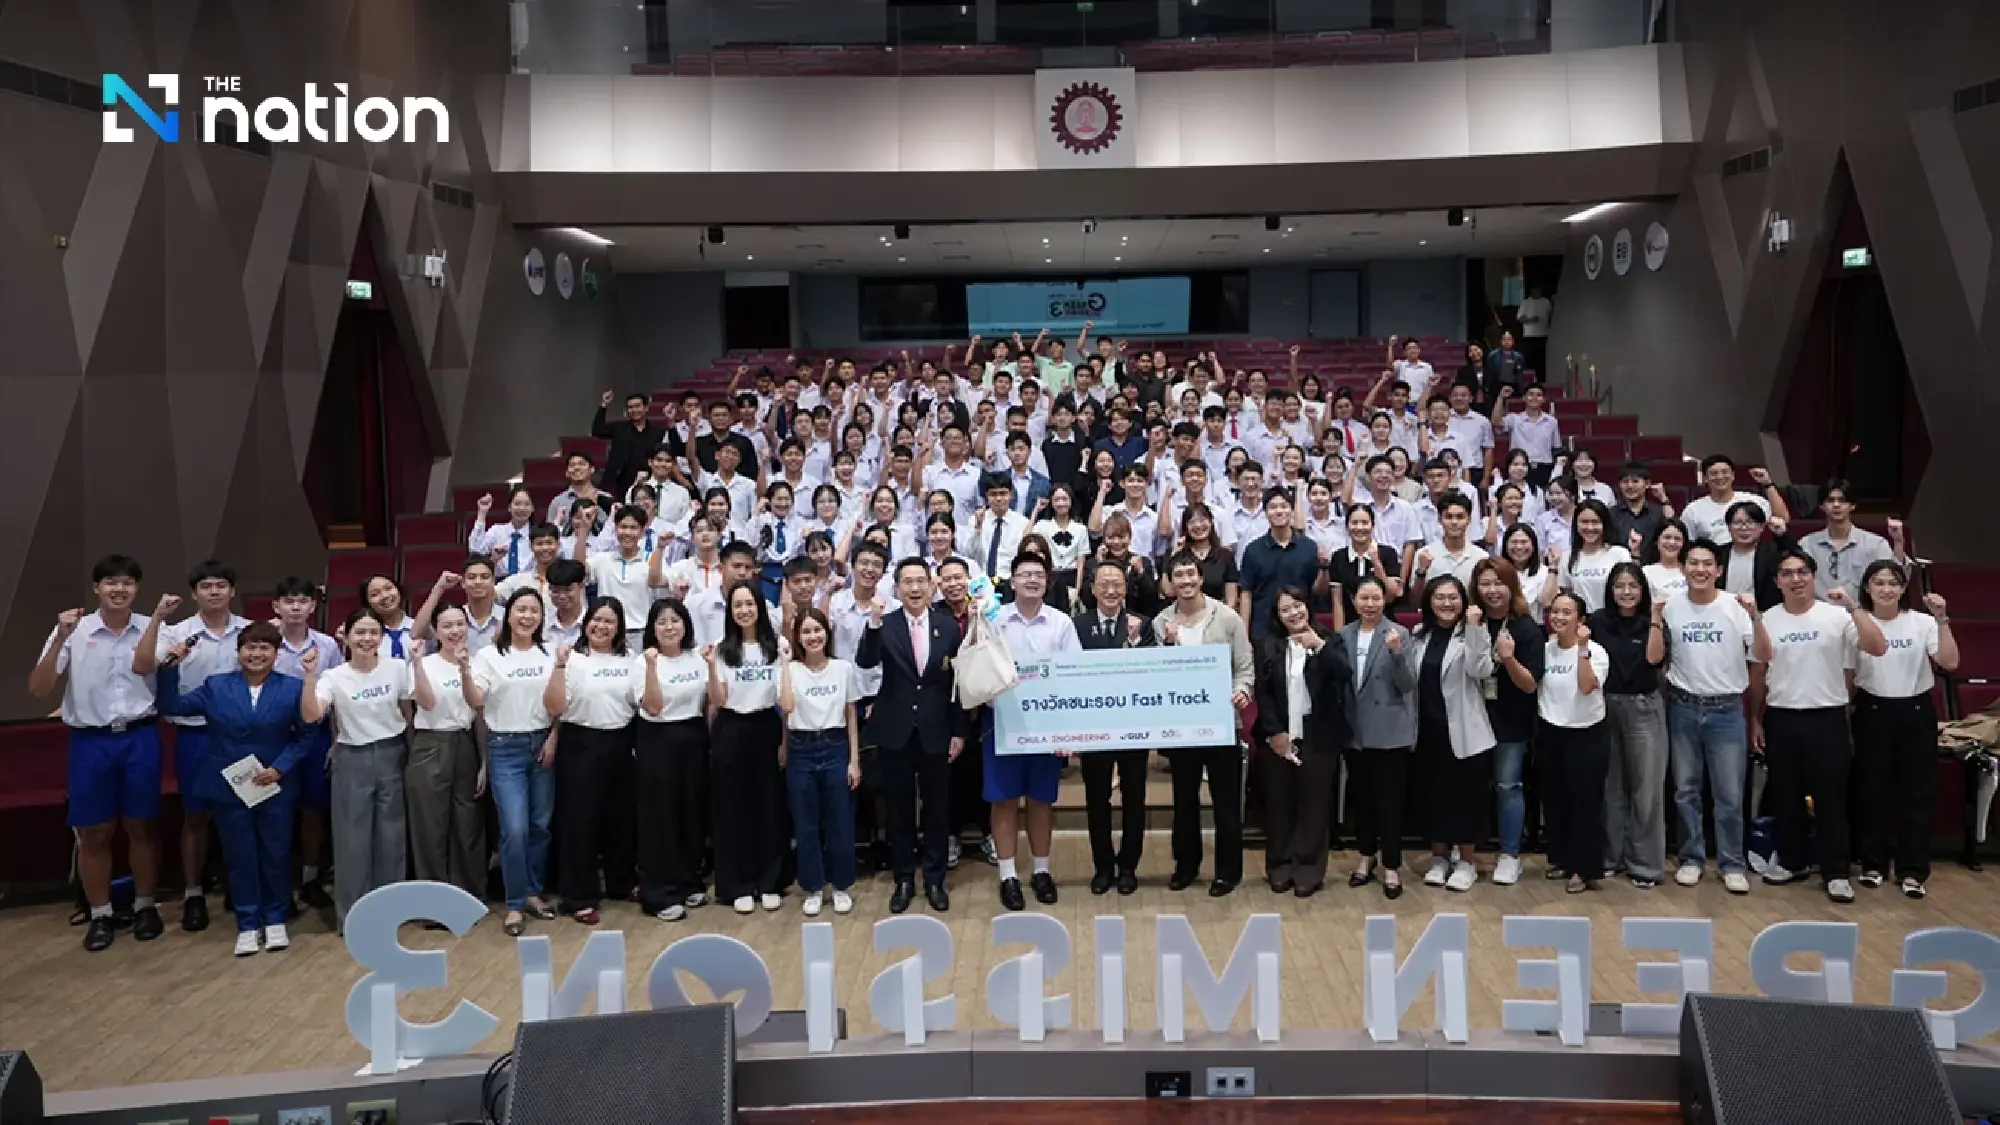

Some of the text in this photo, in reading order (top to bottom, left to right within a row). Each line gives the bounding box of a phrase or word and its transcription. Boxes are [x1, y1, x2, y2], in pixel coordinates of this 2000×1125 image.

[1690, 621, 1715, 629] GULF
[1682, 631, 1723, 643] NEXT
[1790, 631, 1819, 642] GULF
[517, 666, 544, 678] GULF
[602, 668, 629, 678] GULF
[735, 668, 773, 681] NEXT
[361, 684, 392, 699] GULF
[811, 686, 838, 697] GULF
[1131, 692, 1163, 707] Fast
[1168, 688, 1210, 706] Track
[1017, 735, 1048, 745] CHULA
[1127, 731, 1151, 741] GULF
